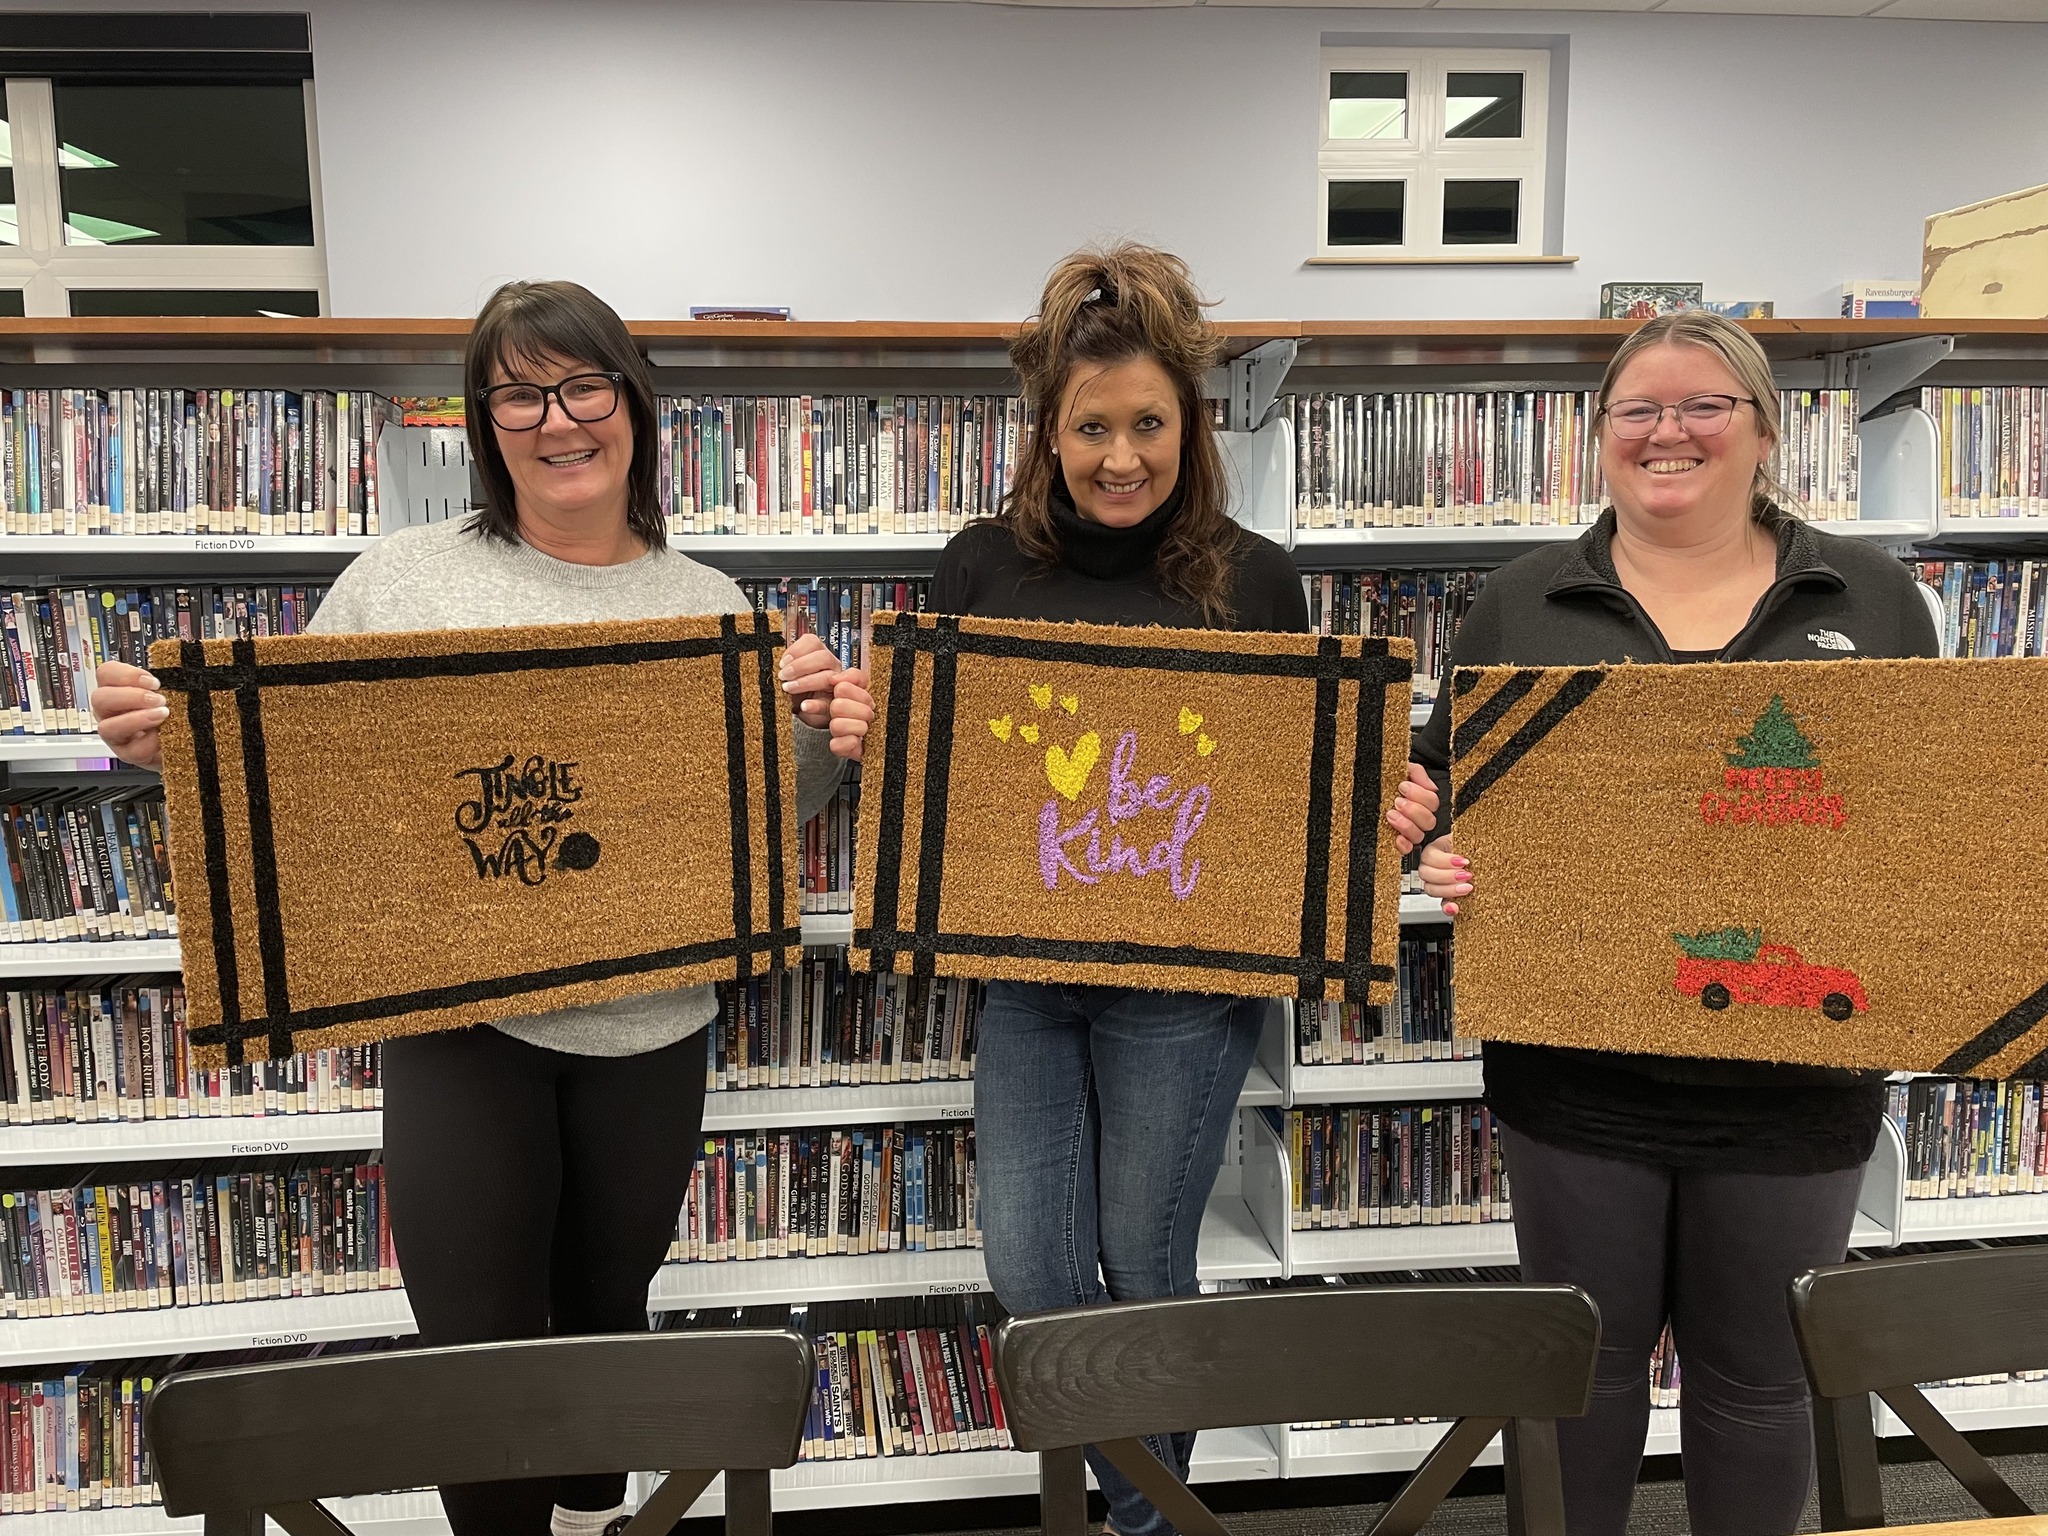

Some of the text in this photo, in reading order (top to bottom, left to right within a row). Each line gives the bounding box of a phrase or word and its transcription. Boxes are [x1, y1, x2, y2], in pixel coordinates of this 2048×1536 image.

[1865, 287, 1914, 298] Ravensburger
[63, 398, 72, 420] AIR
[350, 438, 359, 467] AMERICAN
[1552, 469, 1560, 499] WATER
[196, 540, 254, 550] Fiction DVD
[1807, 633, 1836, 644] NORTH
[1819, 628, 1836, 638] THE
[2025, 609, 2035, 648] MISSING
[1817, 641, 1838, 650] FACE
[23, 651, 35, 681] ANGRY
[46, 644, 59, 687] ANNABELLE
[15, 662, 27, 703] MANAGEMENT
[1108, 731, 1182, 827] be
[454, 755, 582, 834] JINGLE
[67, 811, 79, 841] BATTLE
[95, 836, 111, 878] BEACHES
[107, 832, 118, 854] BEAR
[121, 846, 134, 870] BEAST
[463, 827, 557, 886] WAY
[884, 996, 892, 1036] FORGER
[933, 1024, 941, 1056] RONIN
[35, 1025, 49, 1089] THE BODY
[141, 1027, 153, 1097] BOOK RUTH
[84, 1050, 93, 1097] TOMAHAWK
[942, 1108, 970, 1117] Fiction
[232, 1142, 288, 1154] Fiction DVD
[840, 1163, 850, 1220] GODSEND
[892, 1155, 901, 1216] GOD'S POCKET
[56, 1228, 64, 1246] CALL
[208, 1212, 216, 1237] COUNTER
[255, 1217, 266, 1257] CASTLE FALLS
[44, 1229, 55, 1261] CAKE
[58, 1247, 65, 1257] ME
[65, 1215, 79, 1276] CAMILLE
[930, 1283, 980, 1294] Fiction DVD
[252, 1334, 308, 1346] Fiction DVD
[939, 1332, 949, 1347] HALL
[840, 1346, 848, 1377] GUNLESS
[941, 1347, 952, 1364] PASS
[824, 1409, 832, 1426] who
[832, 1386, 841, 1427] SAINTS
